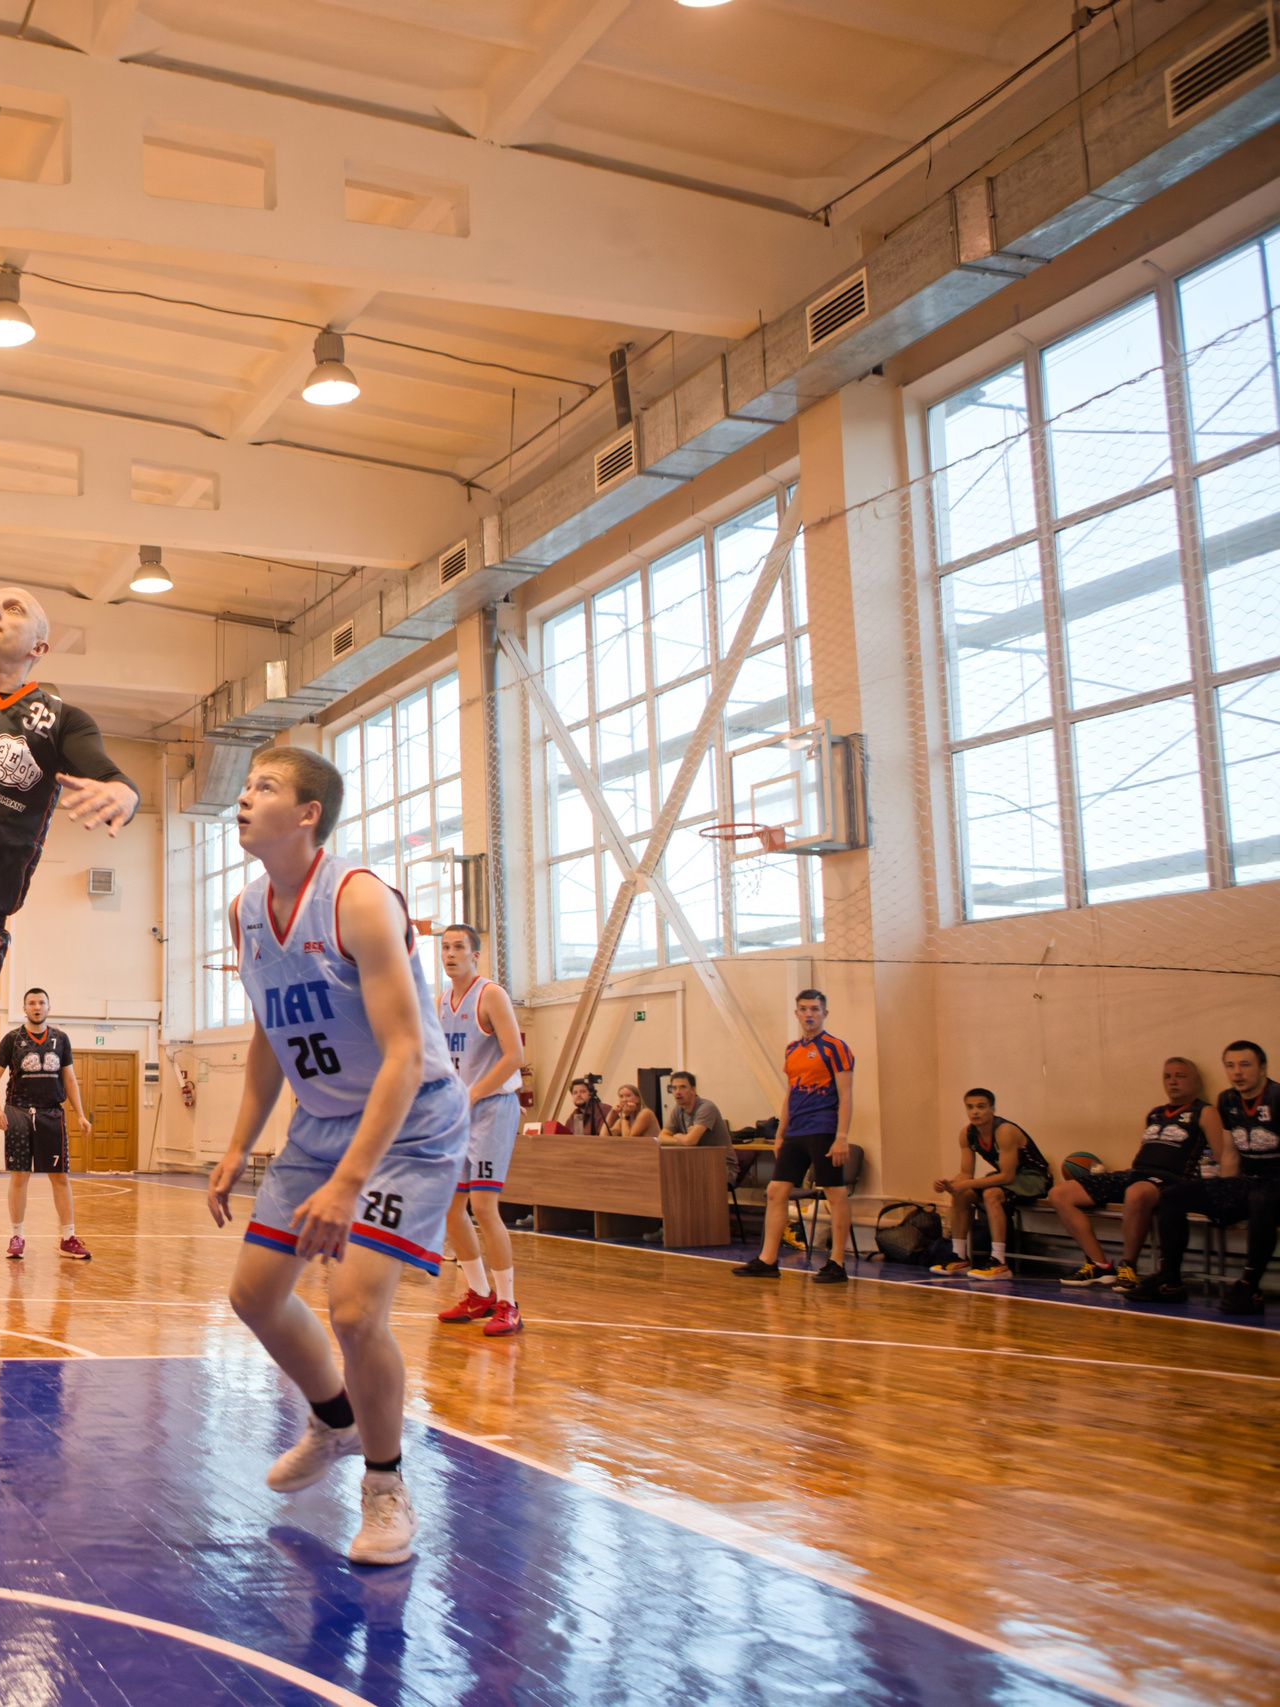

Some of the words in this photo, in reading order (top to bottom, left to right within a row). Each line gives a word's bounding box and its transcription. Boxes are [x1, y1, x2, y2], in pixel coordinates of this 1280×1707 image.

[22, 701, 57, 739] 32
[51, 1038, 57, 1050] 7
[287, 1032, 341, 1080] 26
[53, 1155, 60, 1167] 7
[477, 1160, 494, 1179] 15
[363, 1190, 403, 1230] 26
